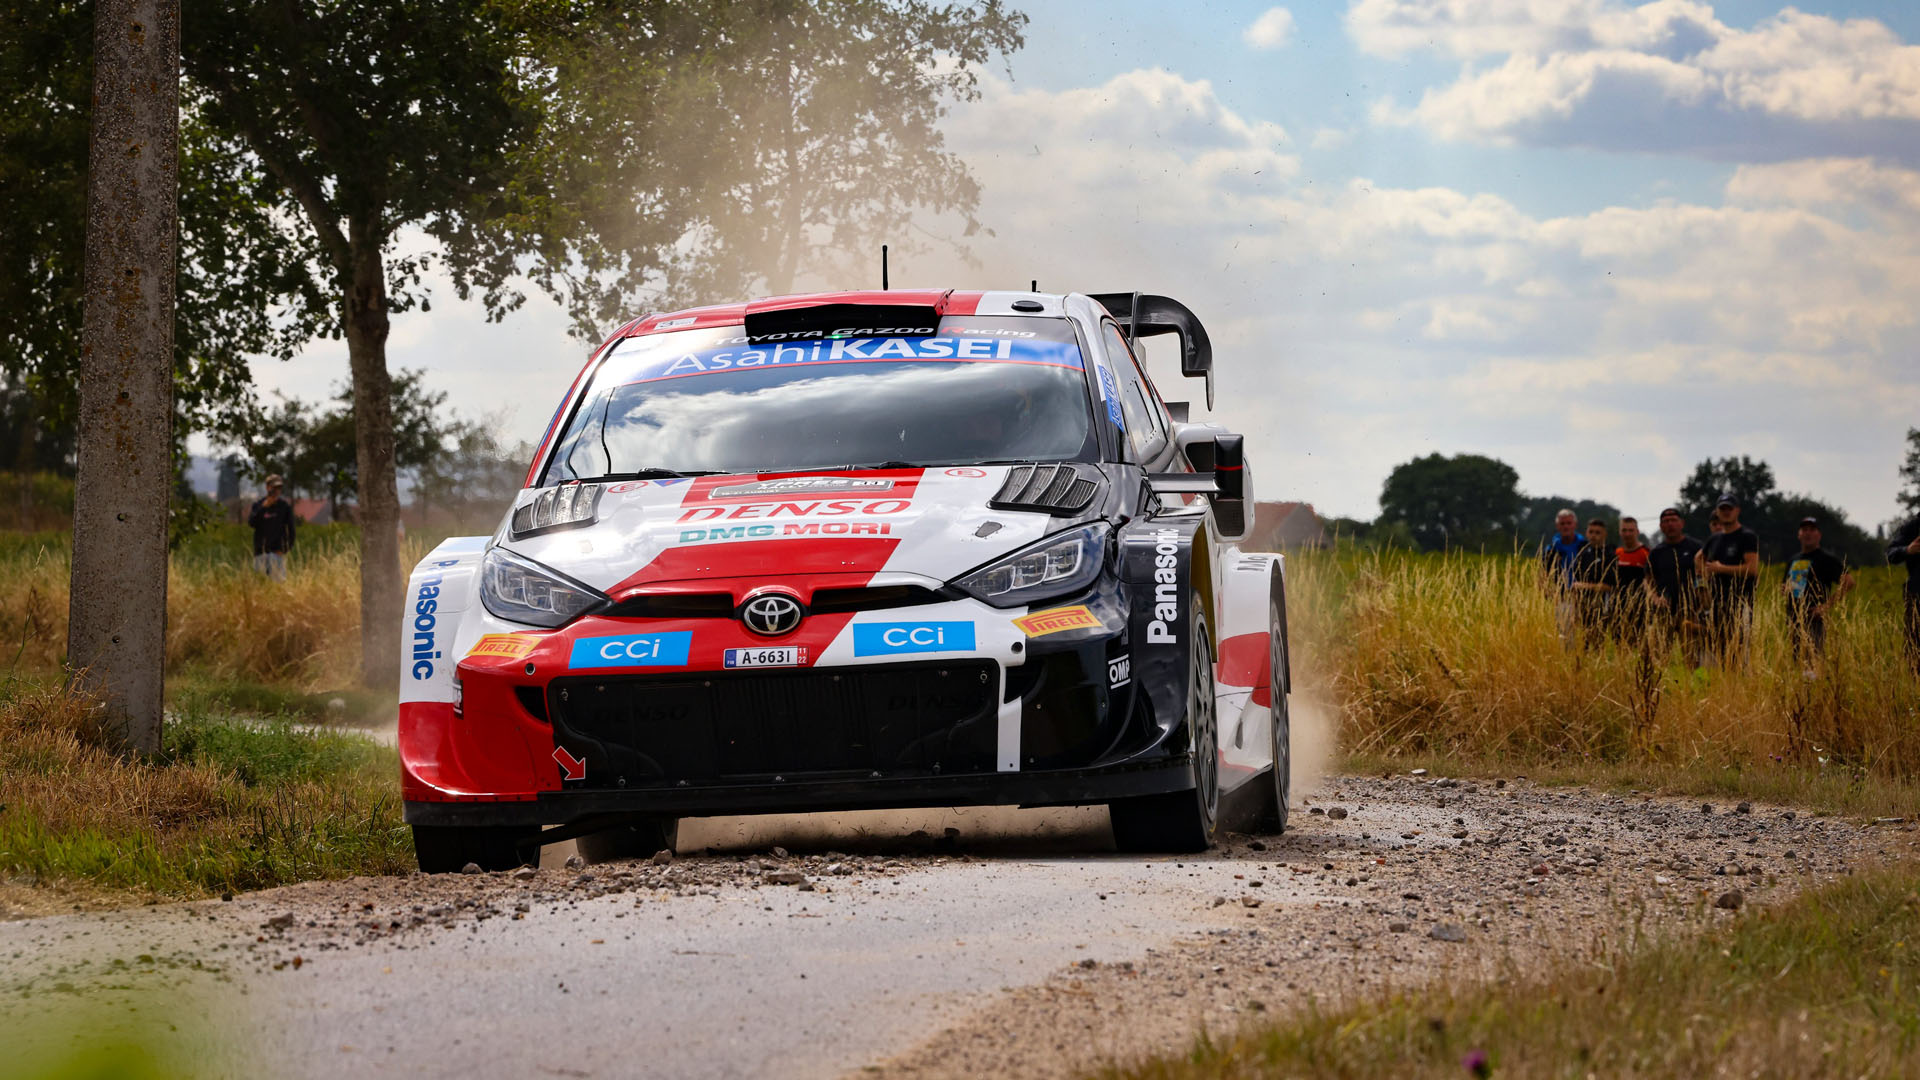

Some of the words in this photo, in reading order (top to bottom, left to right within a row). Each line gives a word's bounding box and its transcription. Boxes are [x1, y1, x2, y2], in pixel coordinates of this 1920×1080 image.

[715, 330, 823, 345] TOYOTA
[830, 327, 934, 337] GAZOO
[941, 326, 1036, 338] Racing
[676, 500, 911, 524] DENSO
[679, 525, 776, 543] DMG
[784, 523, 891, 536] MORI
[1147, 528, 1179, 643] Panasonic
[1020, 609, 1094, 633] PIRELLI
[473, 636, 533, 654] PIRELLI
[1109, 659, 1130, 683] OMP
